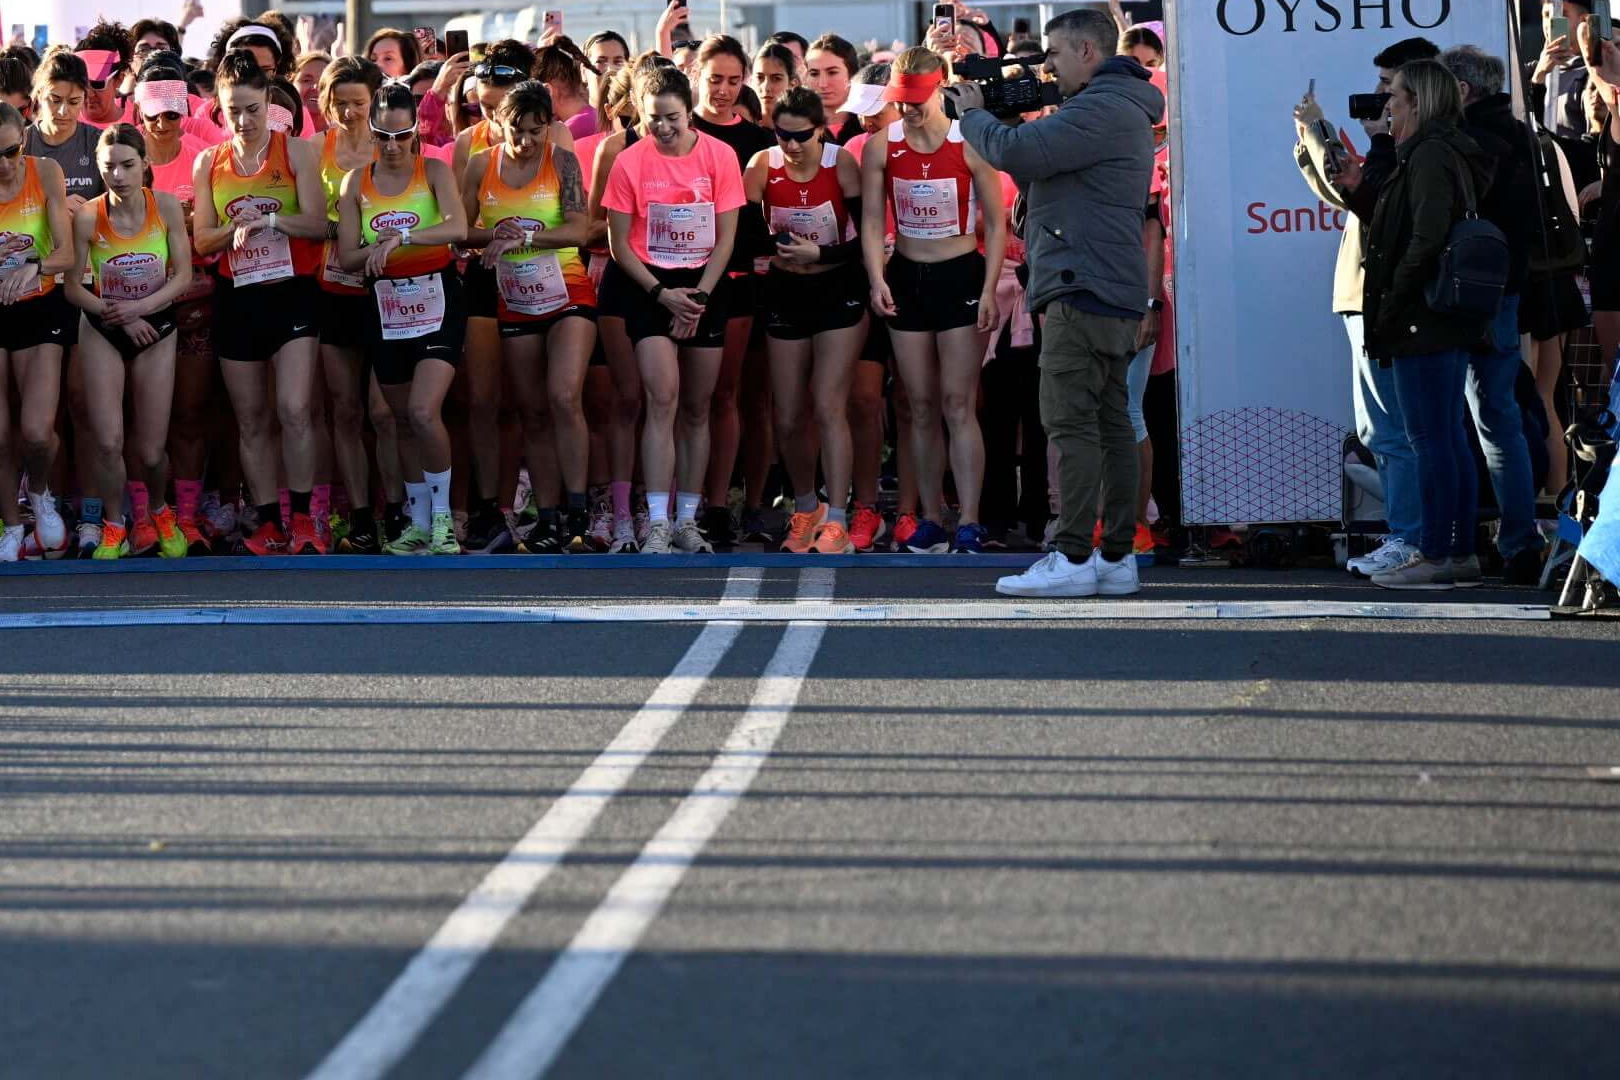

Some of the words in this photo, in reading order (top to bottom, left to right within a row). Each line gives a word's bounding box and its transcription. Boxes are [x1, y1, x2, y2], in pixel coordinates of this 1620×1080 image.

[65, 176, 93, 187] arun
[228, 201, 279, 218] Seano
[912, 206, 938, 216] 016
[371, 214, 419, 230] Serrano
[1247, 201, 1348, 235] Santa
[670, 231, 695, 241] 016
[245, 246, 270, 260] 016
[123, 283, 148, 293] 016
[519, 283, 545, 295] 016
[399, 303, 426, 316] 016
